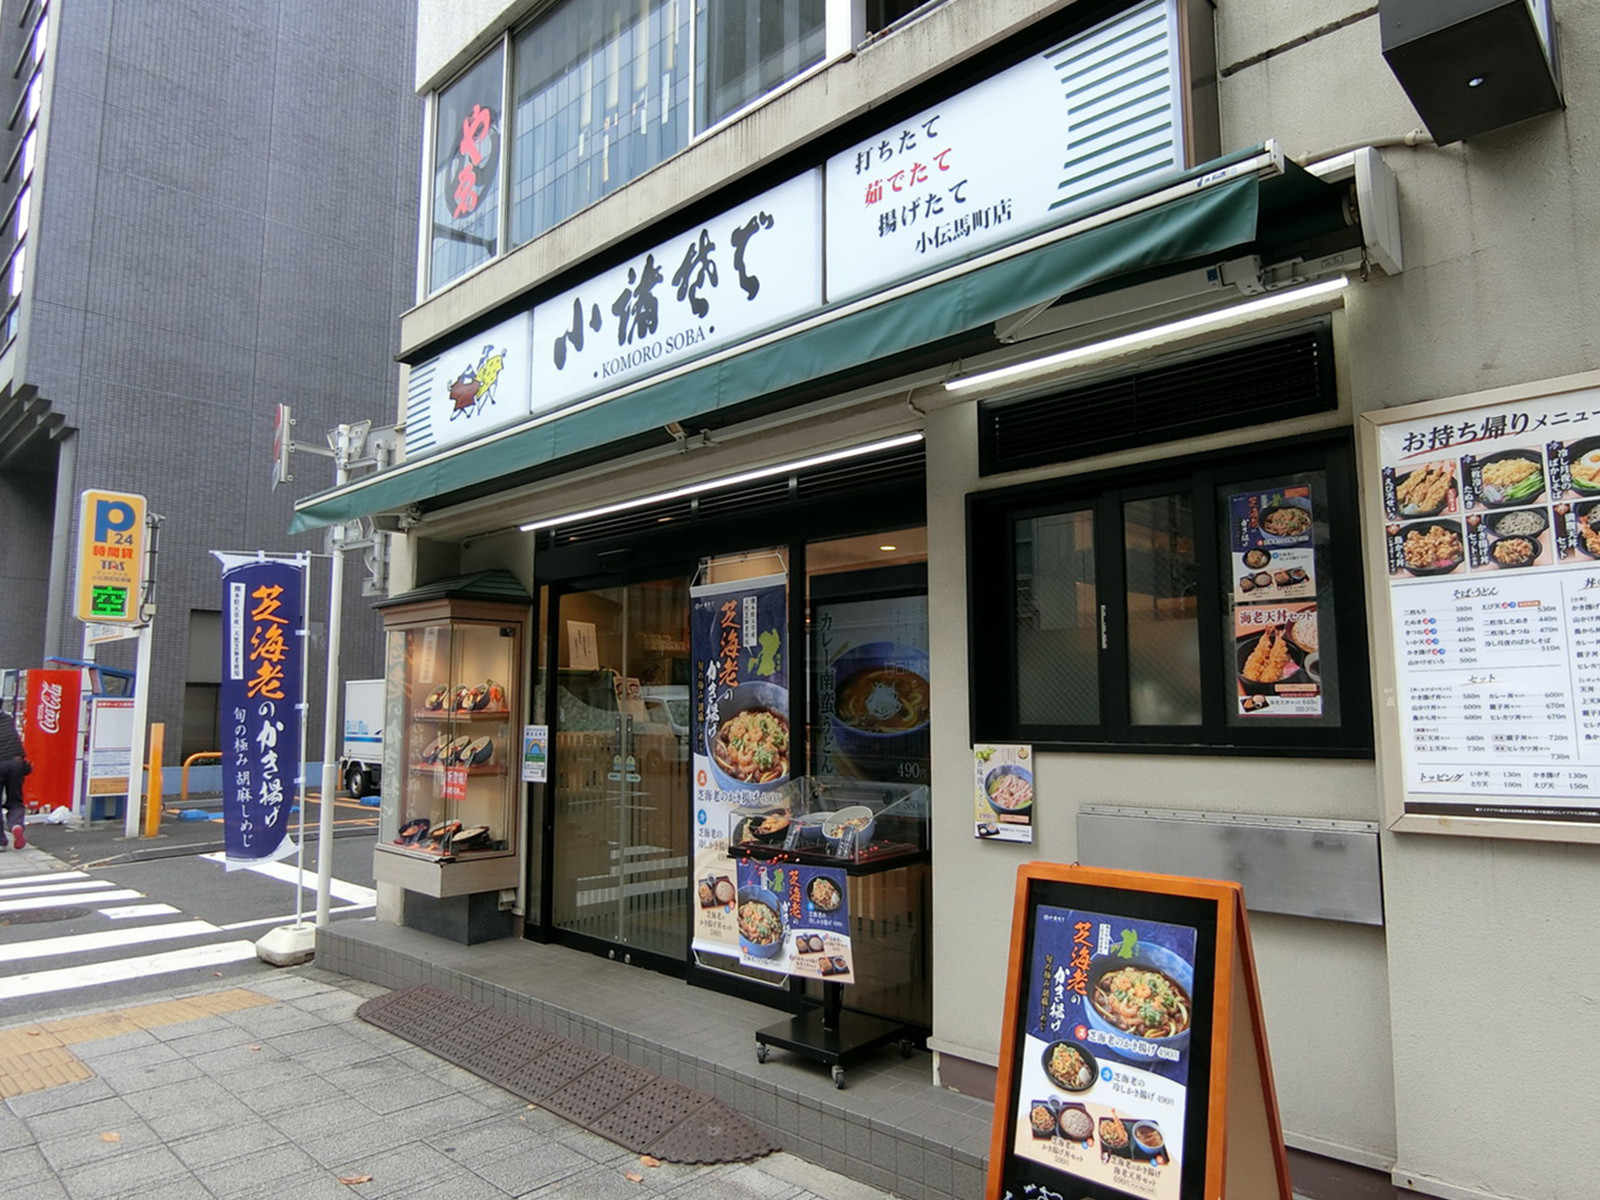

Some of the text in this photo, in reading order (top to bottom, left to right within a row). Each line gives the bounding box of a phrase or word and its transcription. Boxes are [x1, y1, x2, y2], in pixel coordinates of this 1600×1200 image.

[855, 115, 941, 176] 打ちたて
[864, 148, 953, 207] 茹でたて
[878, 179, 969, 238] 揚げたて
[915, 198, 1013, 254] 小伝馬町店
[602, 326, 706, 379] KOMORO SOBA
[94, 499, 136, 543] P
[115, 533, 133, 545] 24
[93, 545, 133, 559] 時間貸
[1240, 610, 1313, 624] 海老天丼セット
[247, 584, 289, 828] 芝海老のかき揚げ
[820, 612, 835, 774] カレー南蛮うどん
[233, 707, 253, 847] 旬の極み 胡麻しめじ
[1050, 966, 1071, 1032] かき揚げ
